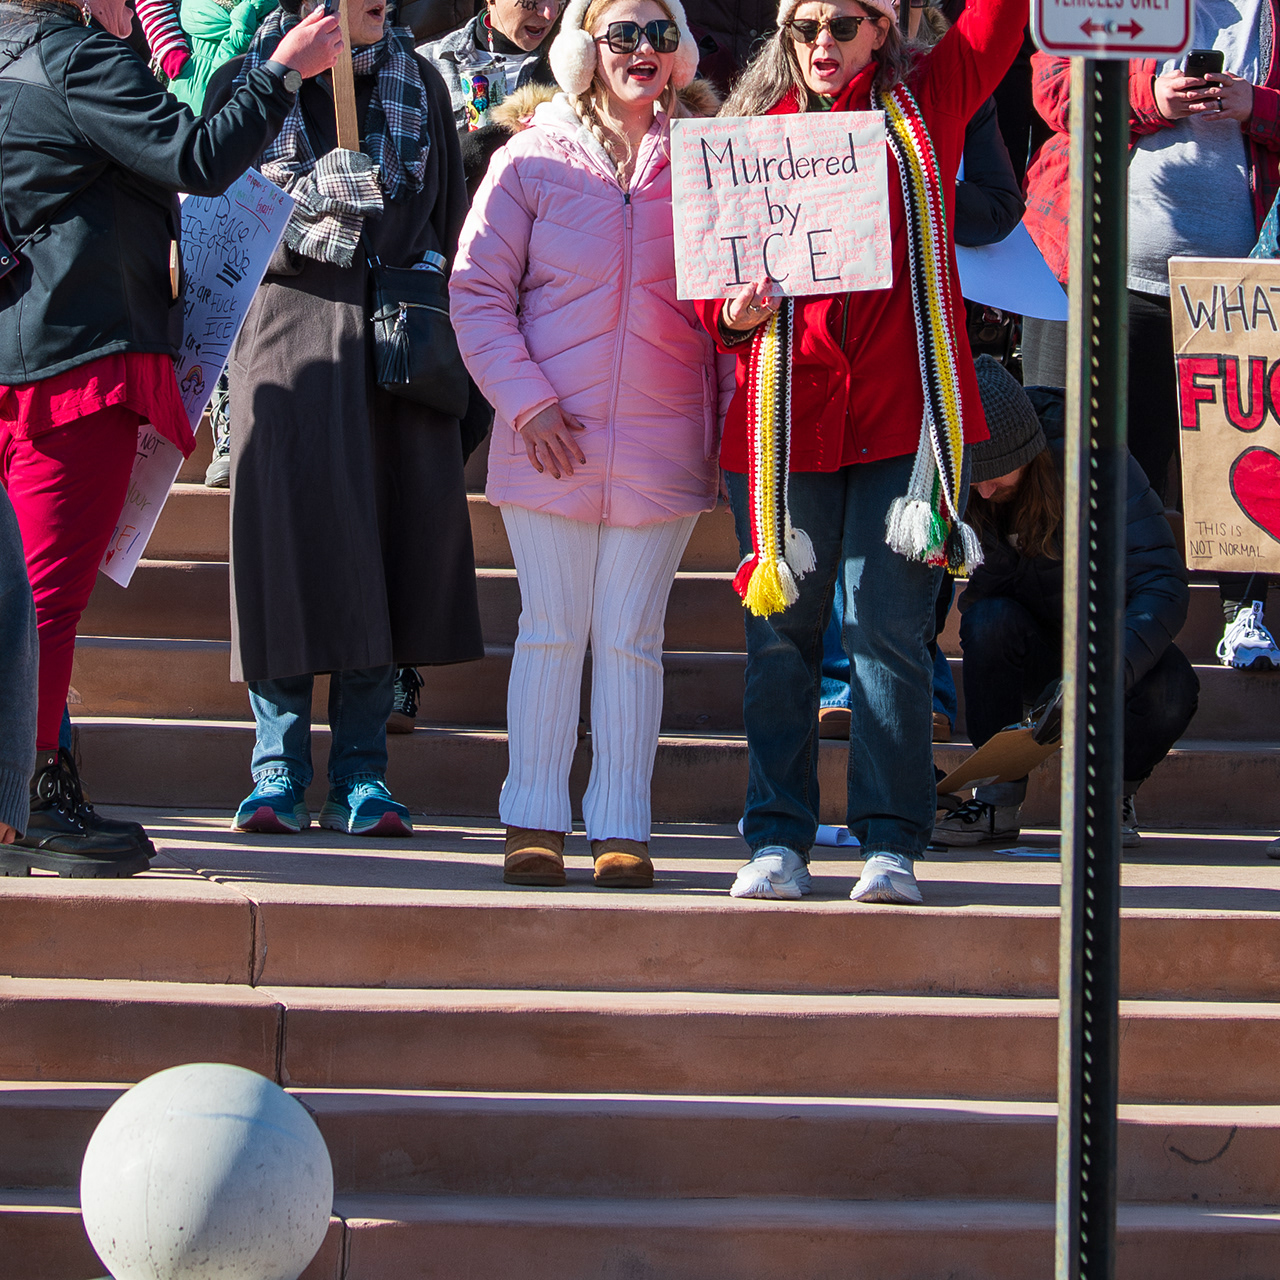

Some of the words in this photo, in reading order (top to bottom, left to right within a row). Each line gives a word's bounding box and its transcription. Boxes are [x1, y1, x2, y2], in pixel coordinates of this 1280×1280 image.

[700, 132, 859, 190] Murdered
[764, 187, 802, 236] by
[720, 228, 841, 286] ICE
[1190, 540, 1215, 556] NOT
[1218, 541, 1266, 559] NORMAL
[1195, 521, 1227, 537] THIS
[1231, 524, 1243, 537] IS
